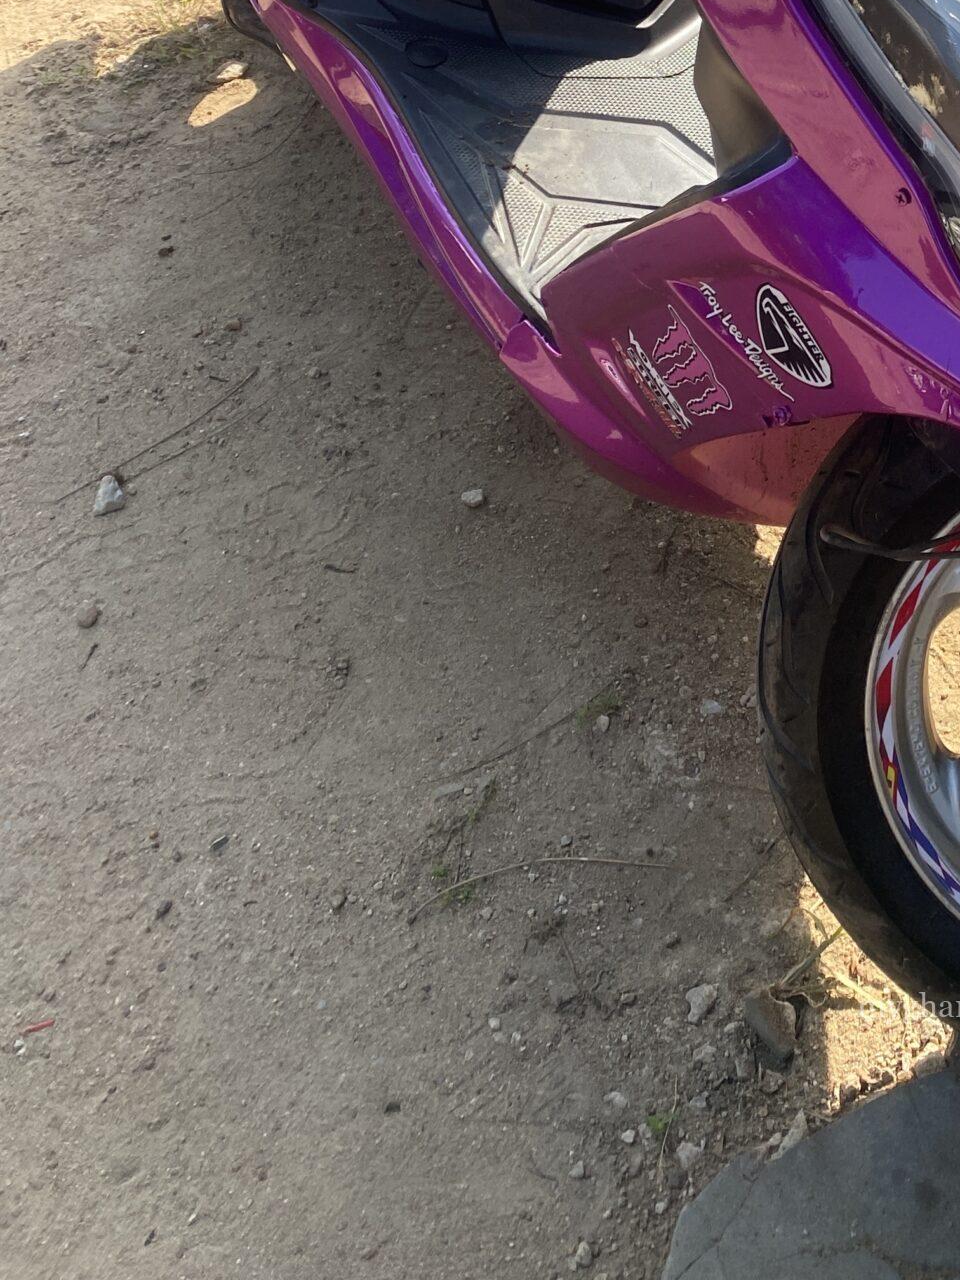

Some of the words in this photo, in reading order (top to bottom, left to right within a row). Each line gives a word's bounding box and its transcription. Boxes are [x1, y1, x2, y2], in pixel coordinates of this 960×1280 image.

[700, 281, 723, 319] Troy
[722, 313, 746, 344] Lee
[744, 338, 795, 402] Designs
[781, 302, 825, 361] FIGHTER
